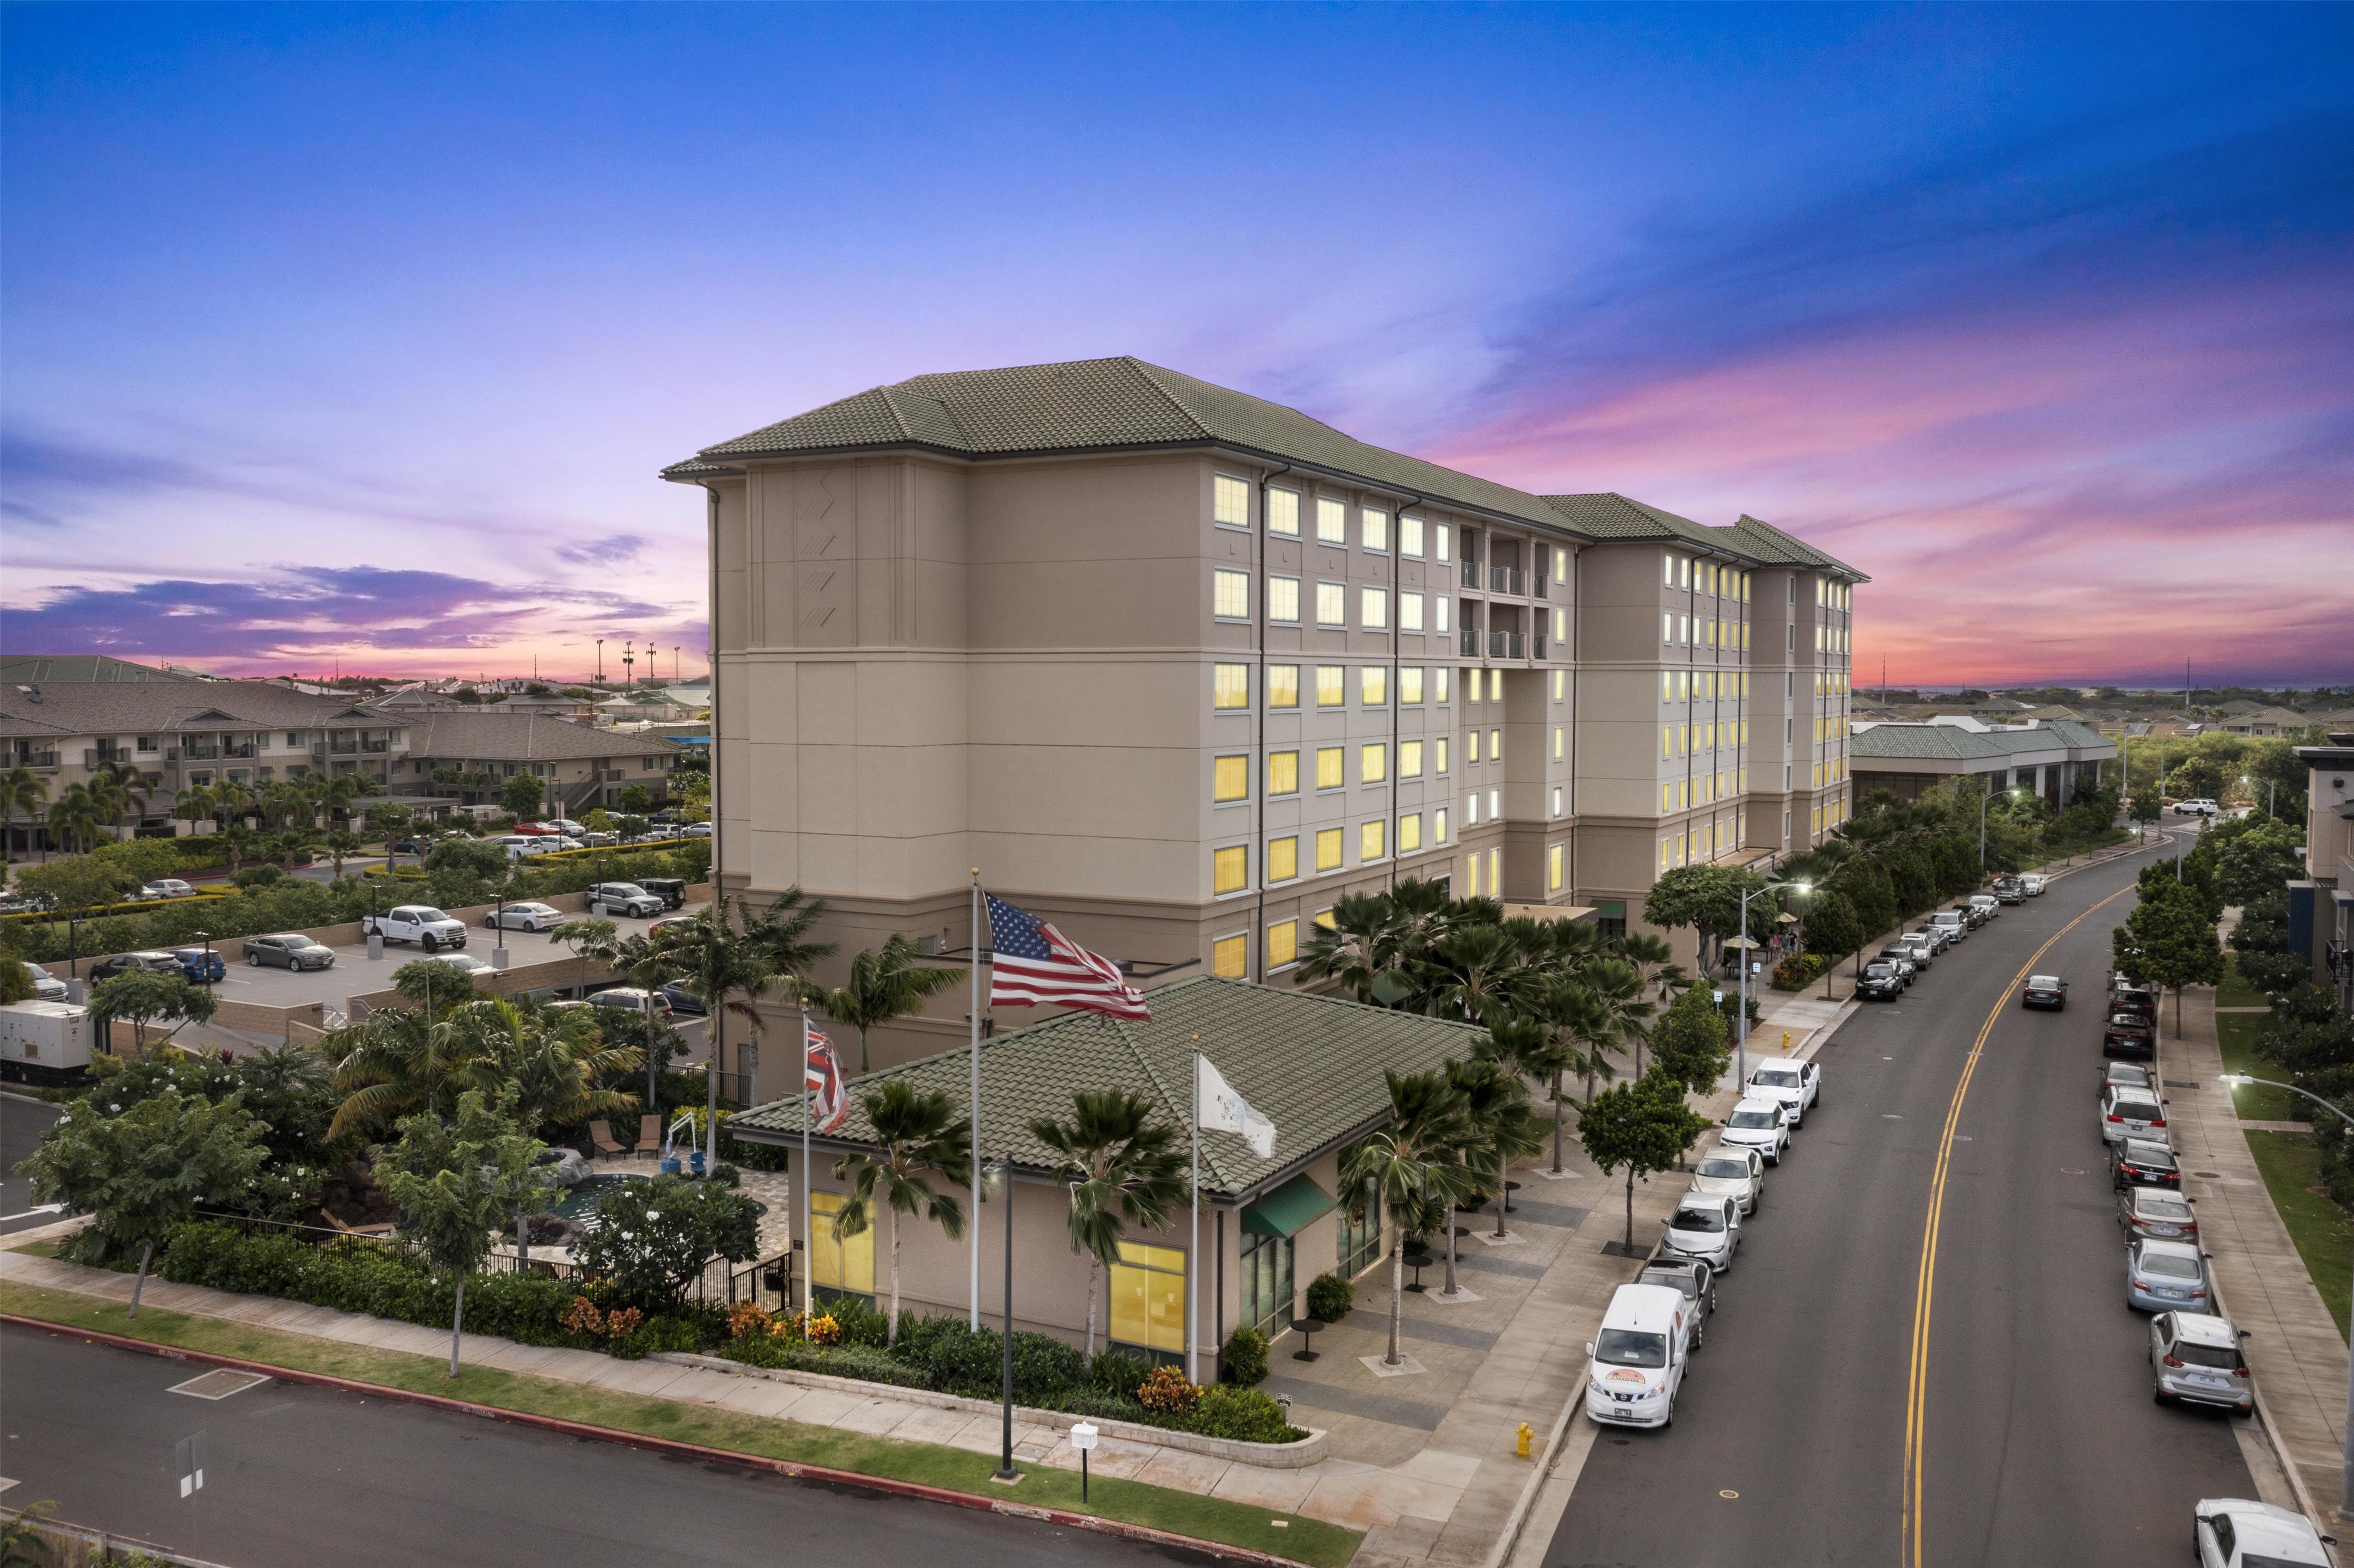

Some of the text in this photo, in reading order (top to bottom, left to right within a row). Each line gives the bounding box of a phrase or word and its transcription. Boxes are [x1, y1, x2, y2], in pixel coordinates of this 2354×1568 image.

[166, 1351, 187, 1360] PARKING
[472, 1407, 495, 1418] PARKING
[784, 1465, 802, 1475] PARKING
